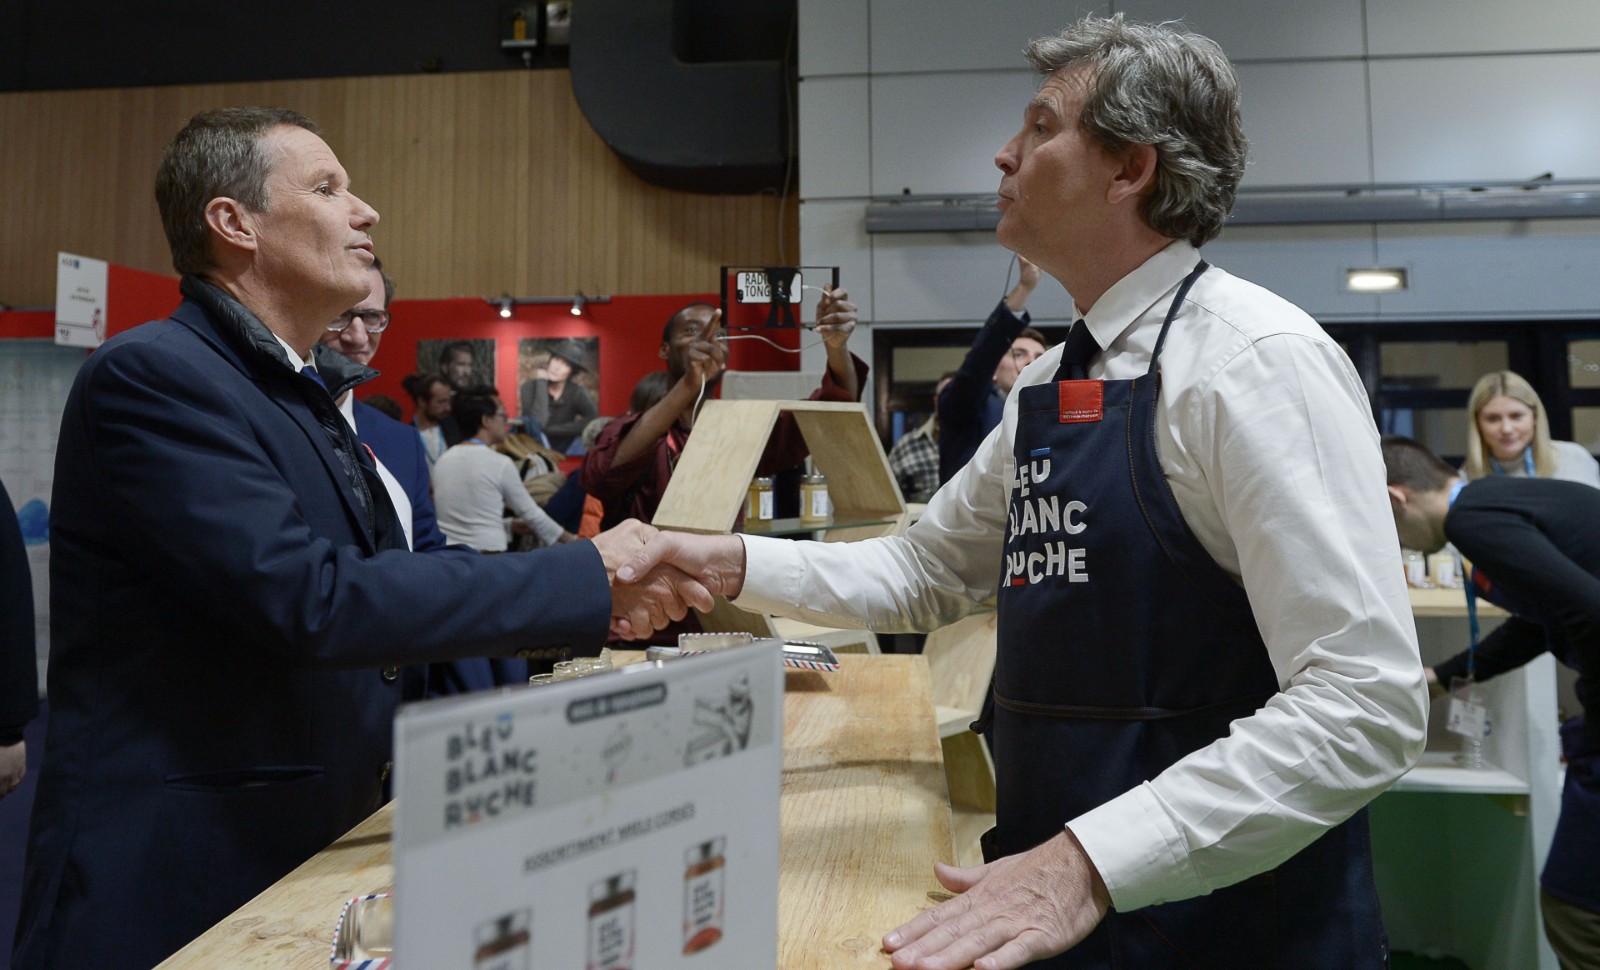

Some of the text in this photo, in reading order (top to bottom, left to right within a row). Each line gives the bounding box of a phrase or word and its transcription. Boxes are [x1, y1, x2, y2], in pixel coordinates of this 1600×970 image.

[1013, 456, 1051, 498] LEU
[1002, 541, 1089, 588] RUCHE
[445, 719, 514, 762] BLEU
[445, 746, 538, 795] BLANC
[444, 780, 536, 829] RUCHE
